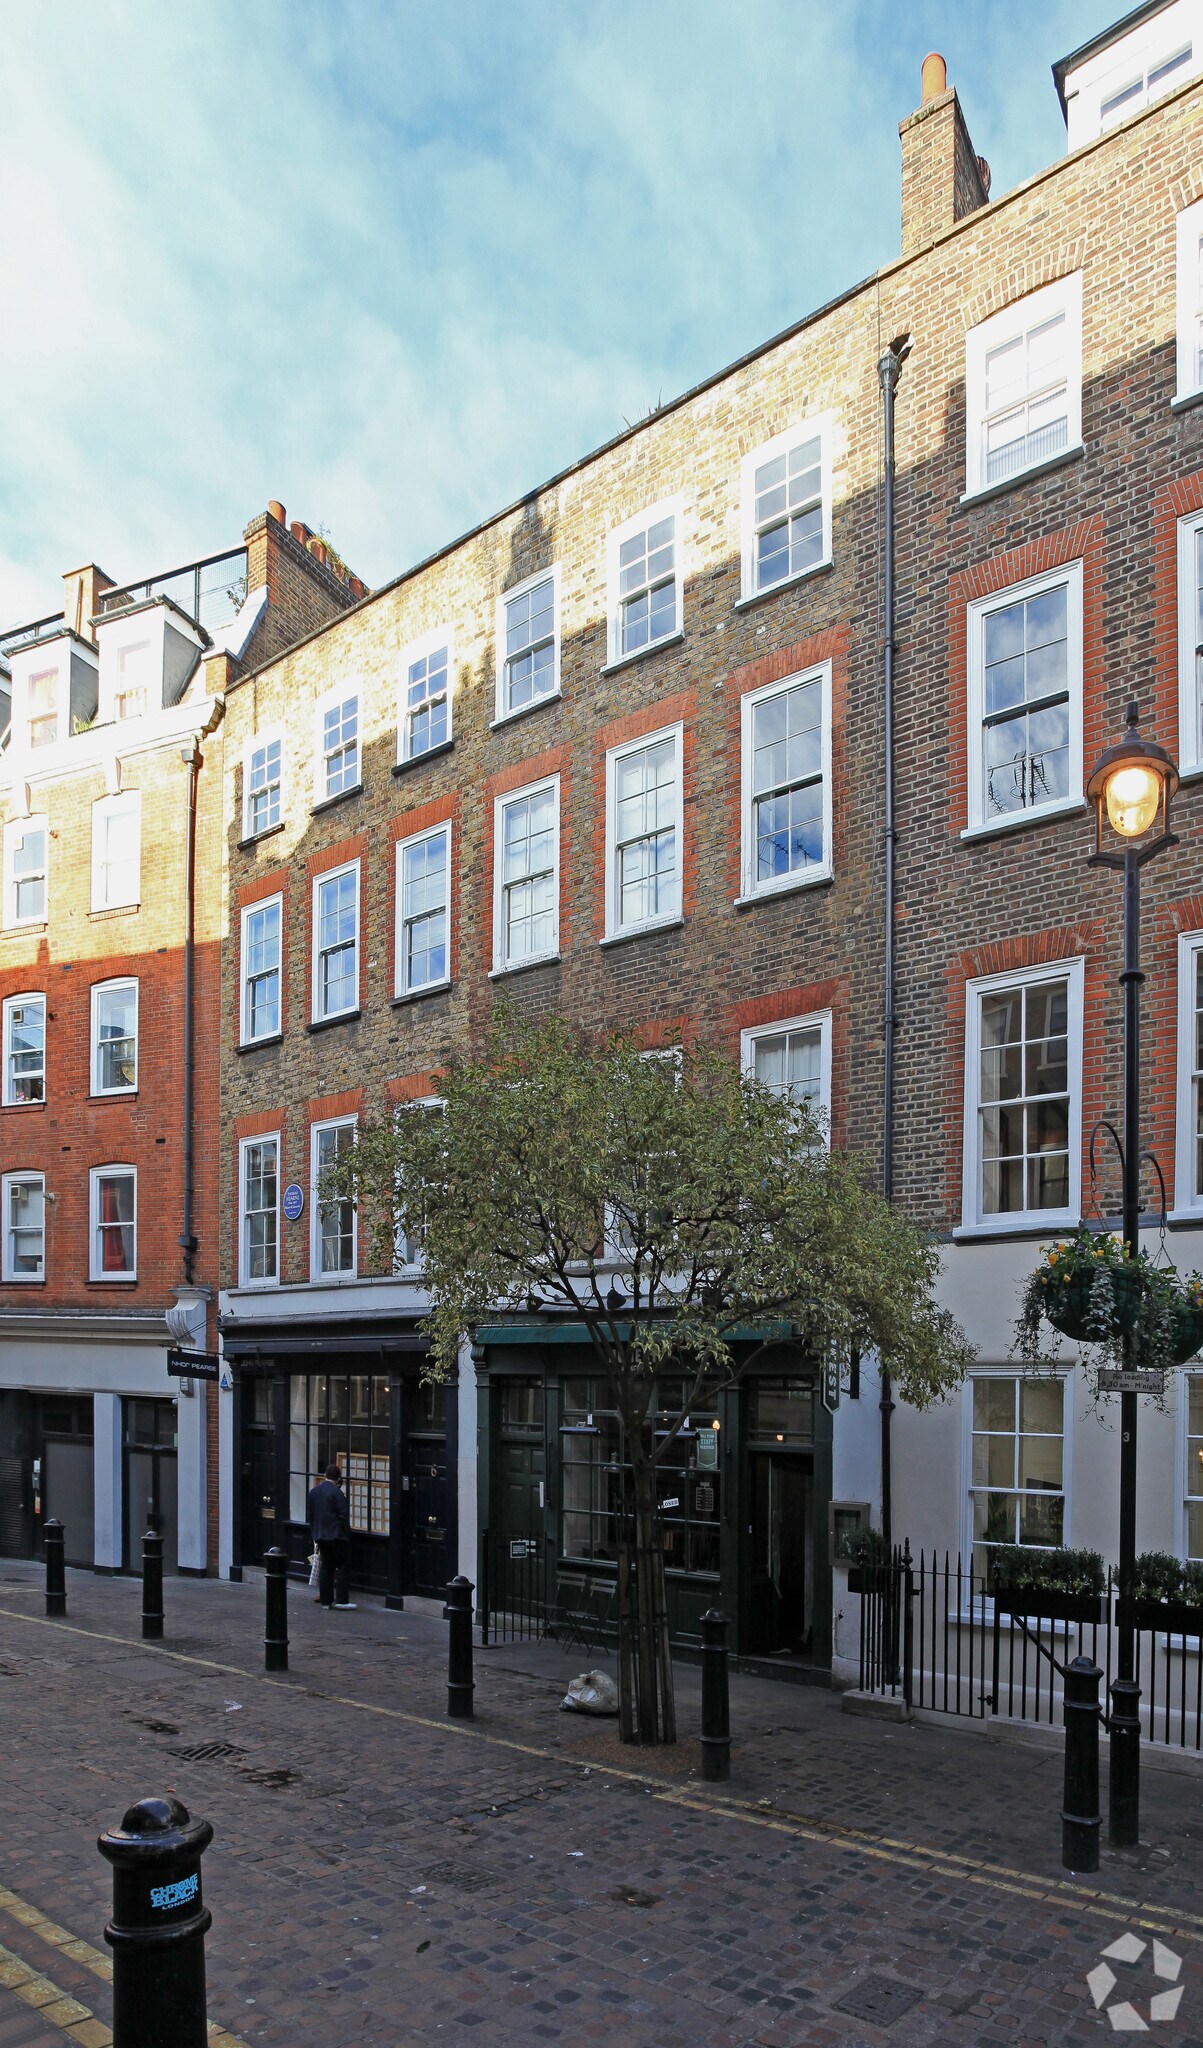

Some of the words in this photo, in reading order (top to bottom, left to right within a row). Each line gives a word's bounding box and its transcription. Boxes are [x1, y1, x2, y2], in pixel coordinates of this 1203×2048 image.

[191, 1363, 217, 1372] PEARSE
[1124, 1374, 1150, 1383] loading
[1123, 1431, 1130, 1442] 3
[150, 1873, 198, 1897] CHROME
[151, 1878, 199, 1908] BLACK
[162, 1894, 195, 1910] LONDON
